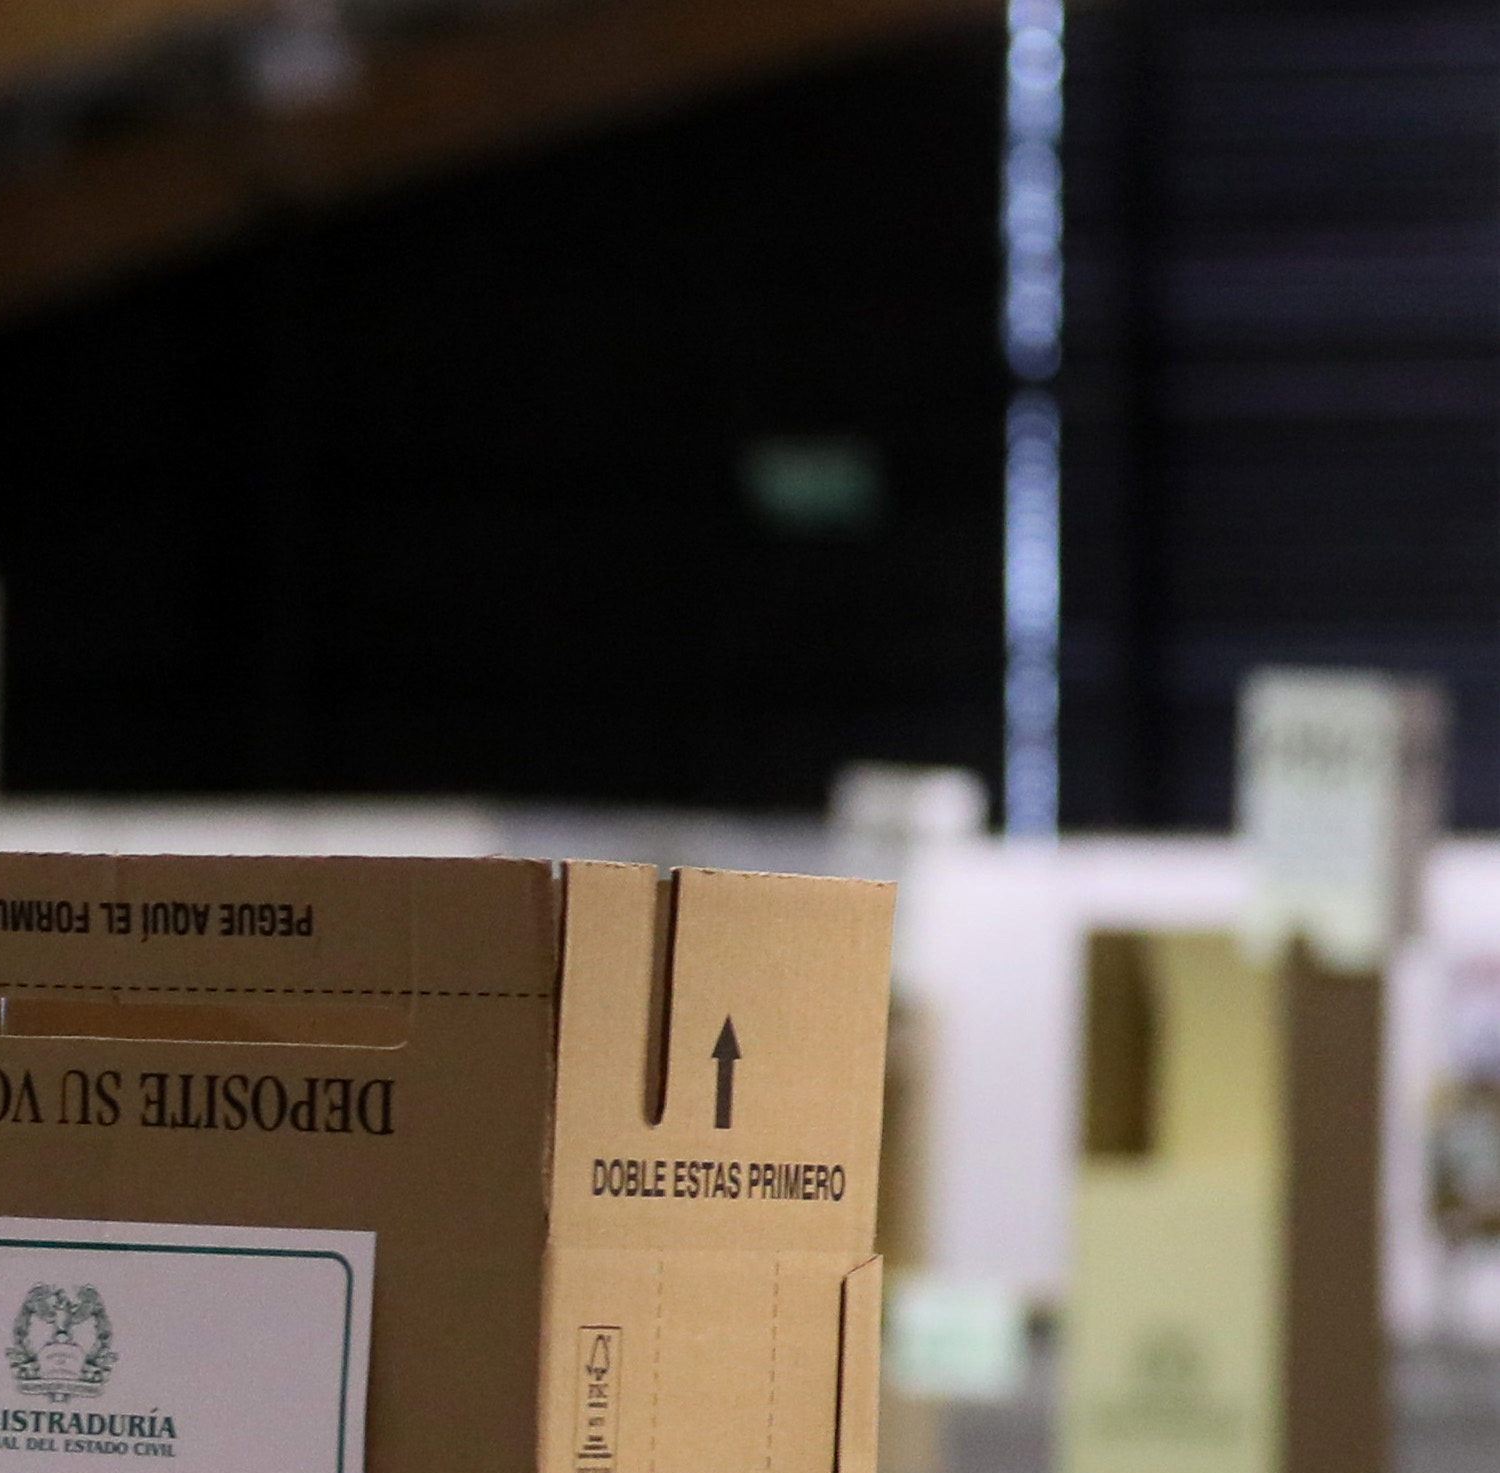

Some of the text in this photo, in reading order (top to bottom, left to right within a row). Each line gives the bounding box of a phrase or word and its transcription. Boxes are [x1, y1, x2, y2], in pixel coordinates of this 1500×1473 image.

[100, 902, 132, 934] EL
[141, 903, 210, 942] AQUÍ
[219, 904, 314, 936] PEGUE
[59, 1069, 122, 1127] SU
[140, 1072, 395, 1135] DEPOSITE
[592, 1158, 846, 1202] DOBLE ESTAS PRIMERO
[26, 1436, 56, 1451] DEL
[64, 1439, 128, 1455] ESTADO
[133, 1442, 176, 1458] CIVIL
